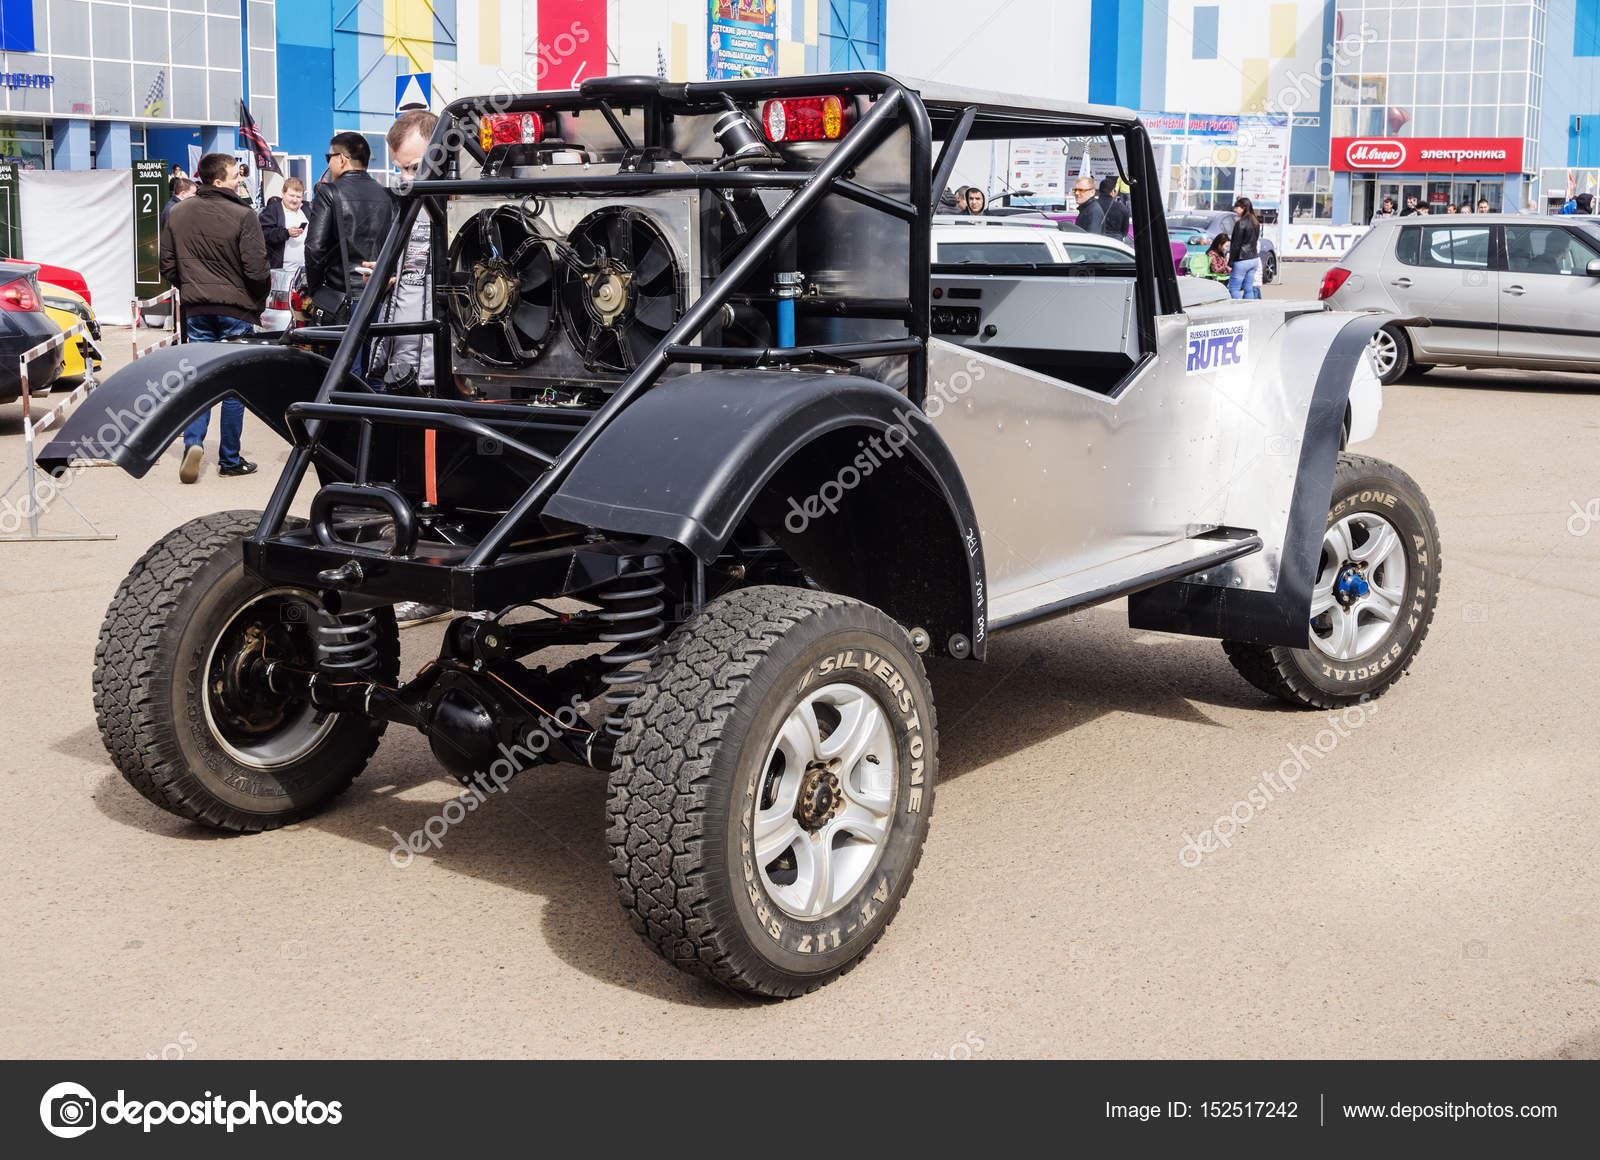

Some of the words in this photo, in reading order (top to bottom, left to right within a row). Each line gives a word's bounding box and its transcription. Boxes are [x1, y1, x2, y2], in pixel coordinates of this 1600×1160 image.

[6, 72, 55, 90] ЦЕНТР
[136, 162, 162, 170] ВЫДАЧА
[1421, 150, 1506, 163] электроника
[139, 170, 162, 178] ЗАКАЗА
[142, 193, 153, 213] 2
[1189, 329, 1210, 340] RUSSIAN
[1210, 326, 1244, 337] TECHNOLOGIES
[1186, 334, 1244, 371] RUTEC
[1407, 534, 1429, 633] AT-117
[1322, 642, 1402, 681] SPECIAL
[818, 651, 926, 814] SILVERSTONE
[797, 876, 889, 953] AT-117
